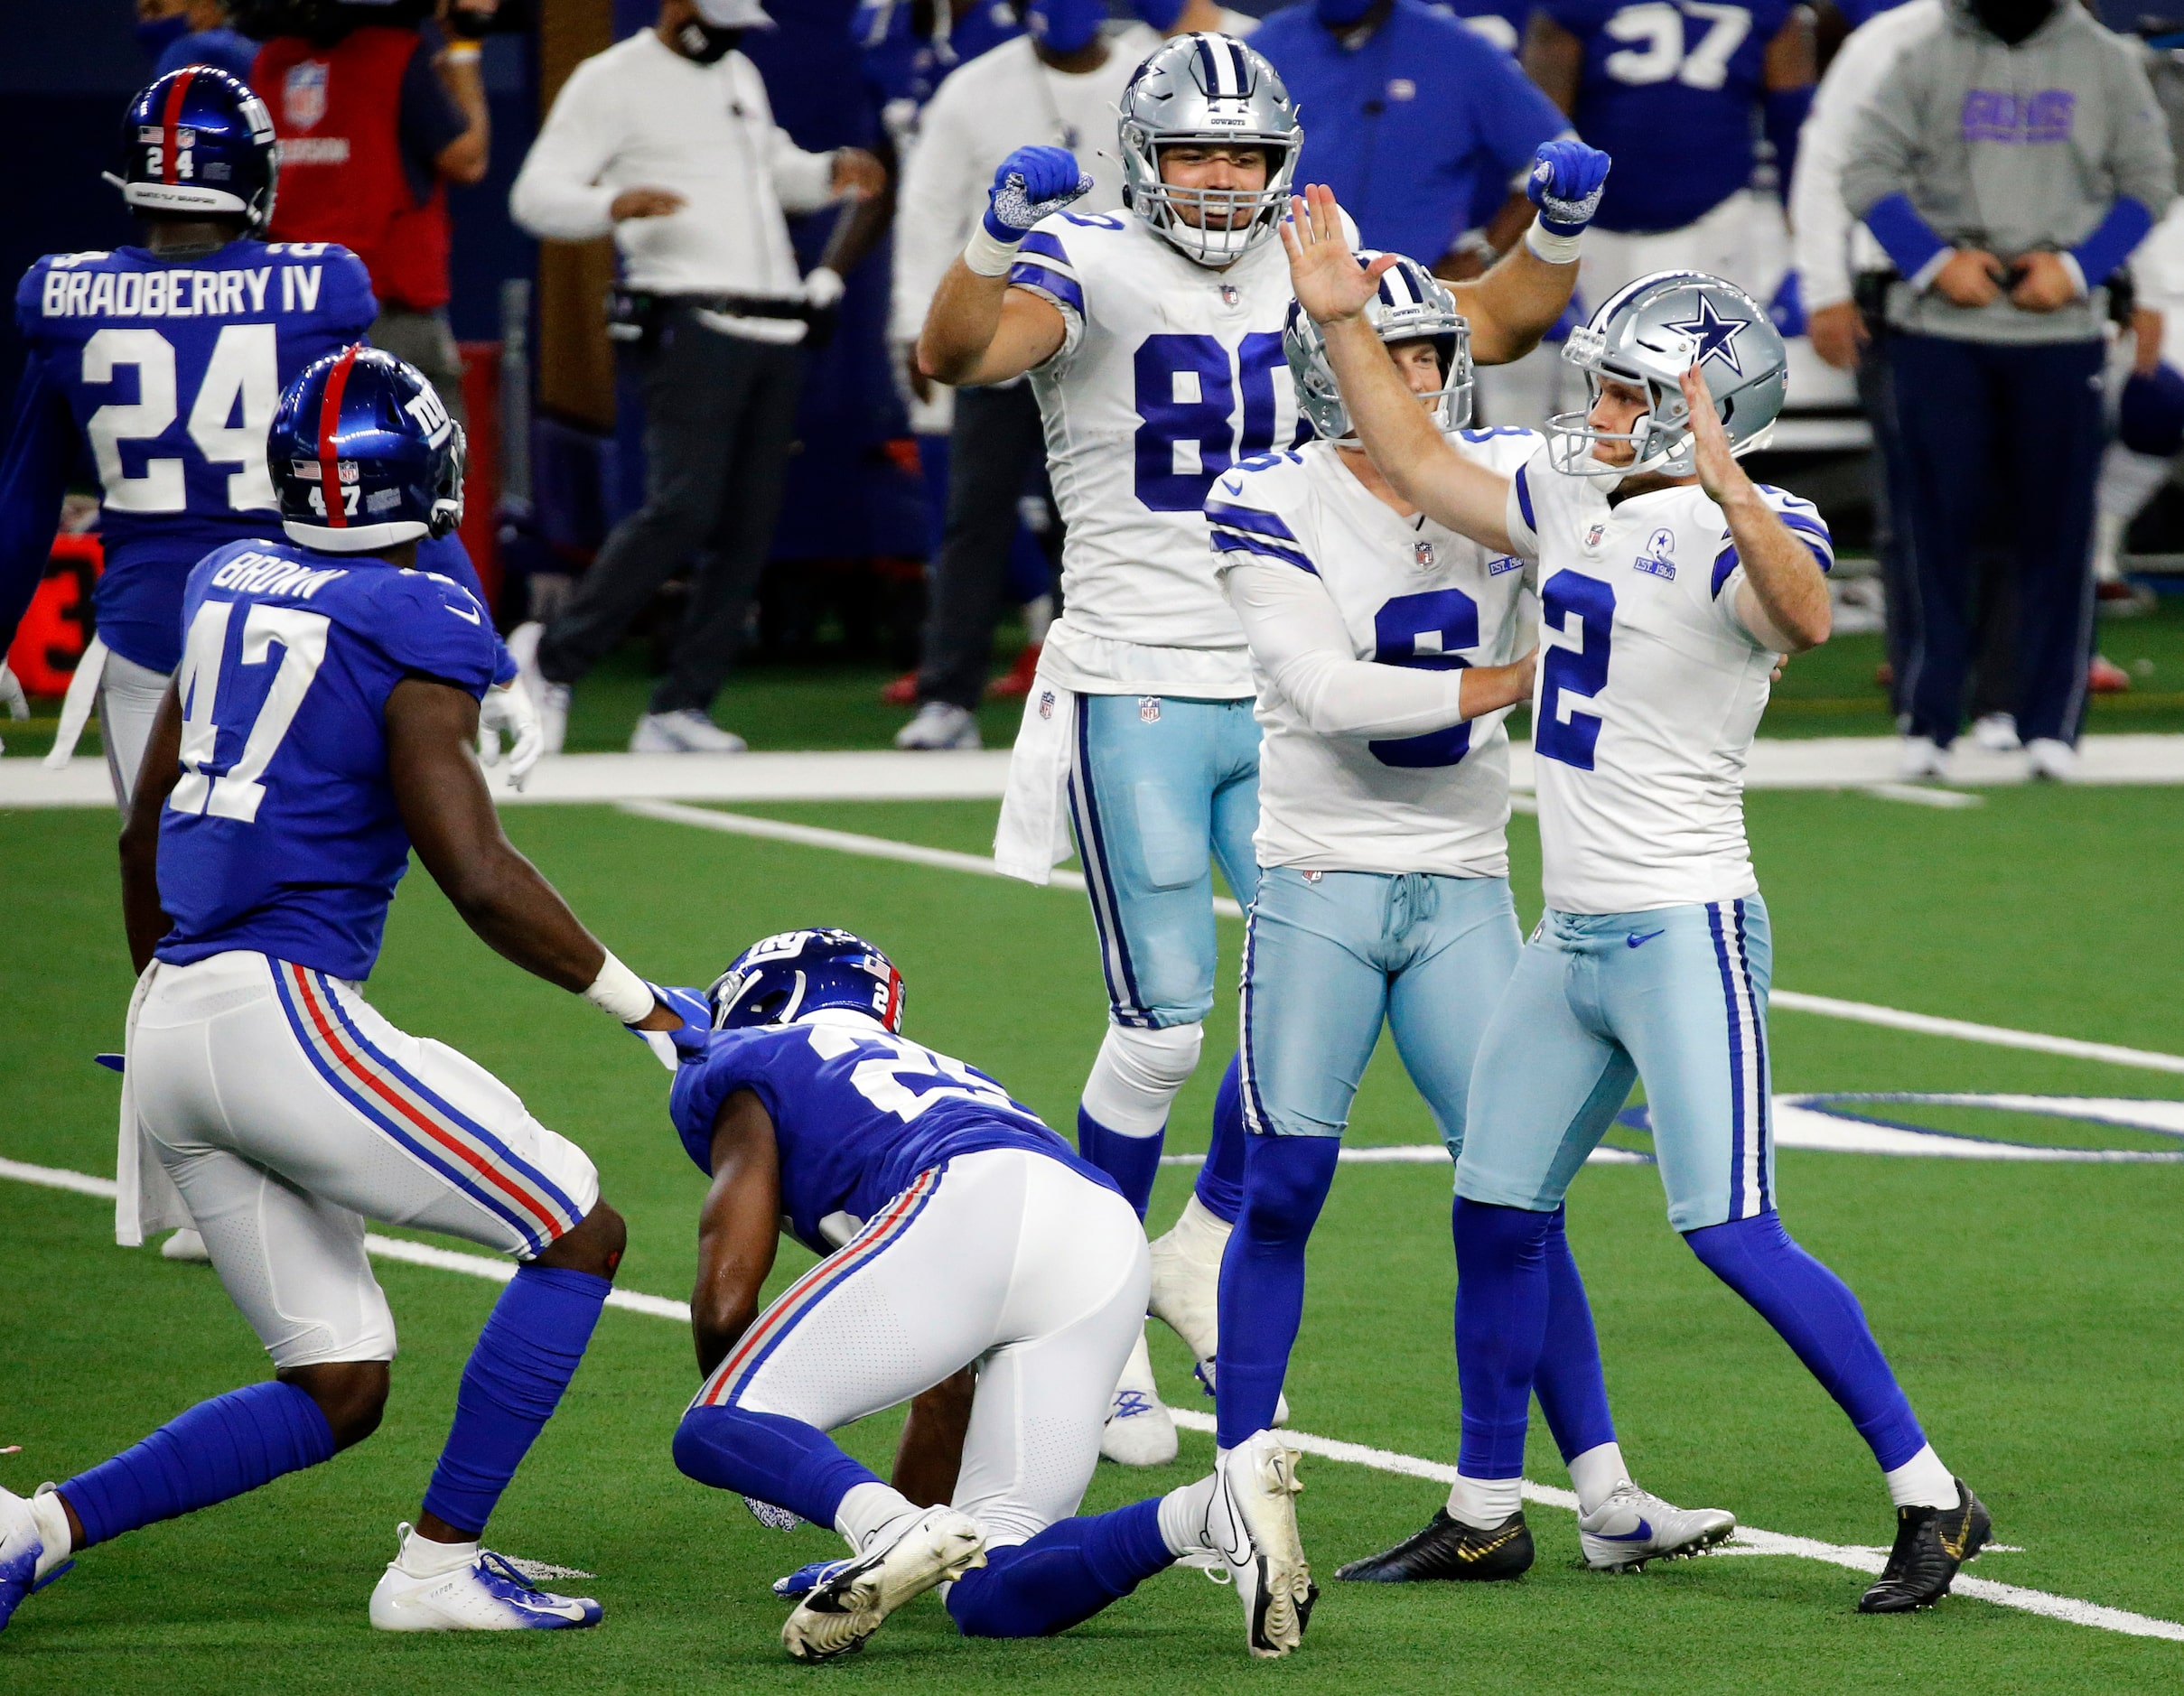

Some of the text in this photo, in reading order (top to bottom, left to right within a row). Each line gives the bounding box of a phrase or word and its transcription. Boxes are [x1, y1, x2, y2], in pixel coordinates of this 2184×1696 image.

[146, 146, 194, 179] 24
[42, 266, 322, 318] BRADBERRY IV
[82, 323, 279, 512] 24
[1134, 331, 1315, 512] 80
[308, 486, 360, 516] 47
[211, 551, 349, 600] BROWN
[1490, 560, 1508, 574] EST.
[1635, 559, 1675, 579] EST. 1960
[1535, 568, 1617, 771] 2
[168, 600, 331, 824] 47
